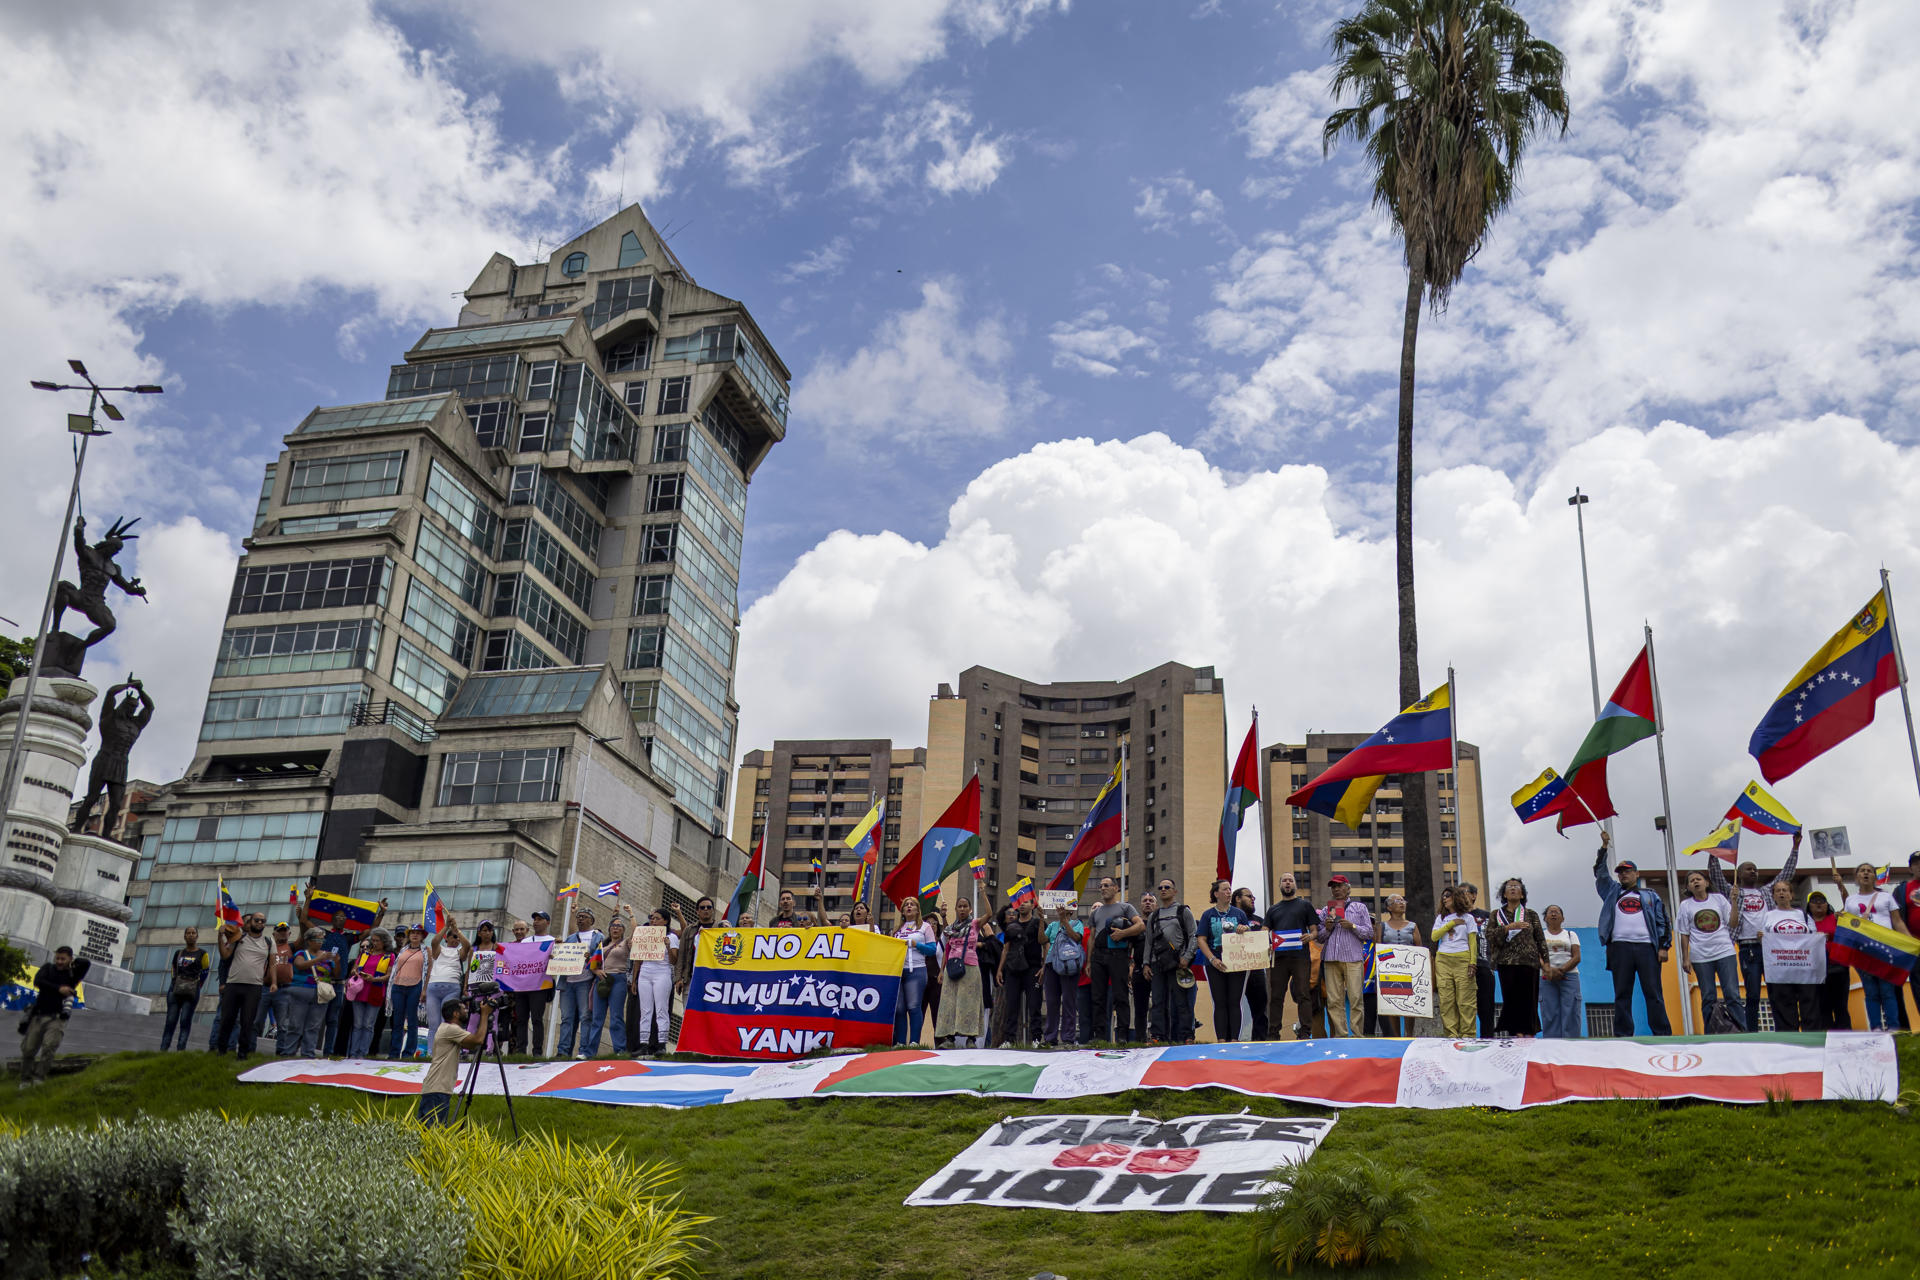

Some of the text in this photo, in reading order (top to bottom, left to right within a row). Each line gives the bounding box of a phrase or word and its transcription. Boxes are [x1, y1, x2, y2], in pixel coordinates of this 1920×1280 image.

[12, 829, 44, 842] PASEO
[650, 944, 658, 952] LA
[752, 933, 849, 960] NO AL
[511, 967, 547, 977] VENEZUEL
[702, 981, 881, 1012] SIMULACRO
[1413, 995, 1427, 1008] 25
[1052, 1143, 1200, 1174] GO
[930, 1168, 1295, 1206] HOME
